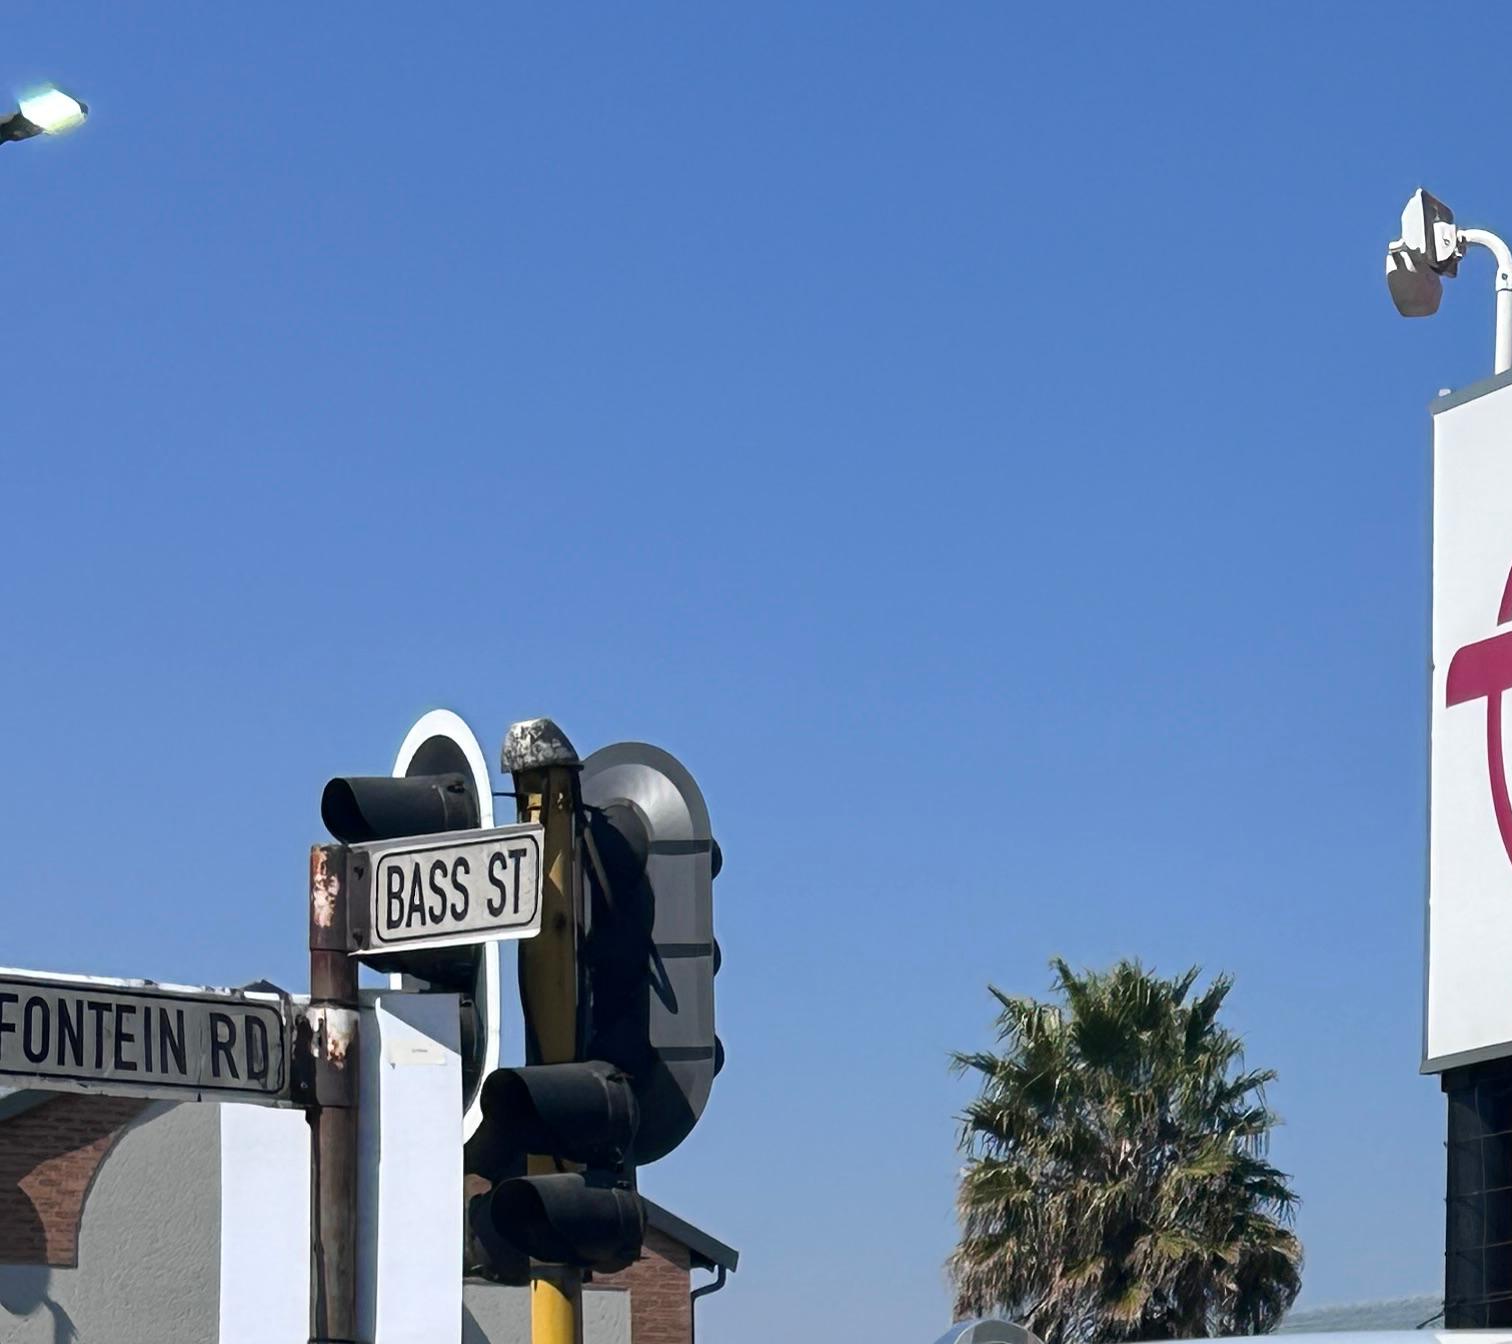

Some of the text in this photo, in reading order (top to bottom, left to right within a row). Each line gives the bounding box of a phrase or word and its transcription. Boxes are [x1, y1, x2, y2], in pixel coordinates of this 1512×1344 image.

[387, 848, 527, 930] BASS ST
[209, 1012, 268, 1080] RD
